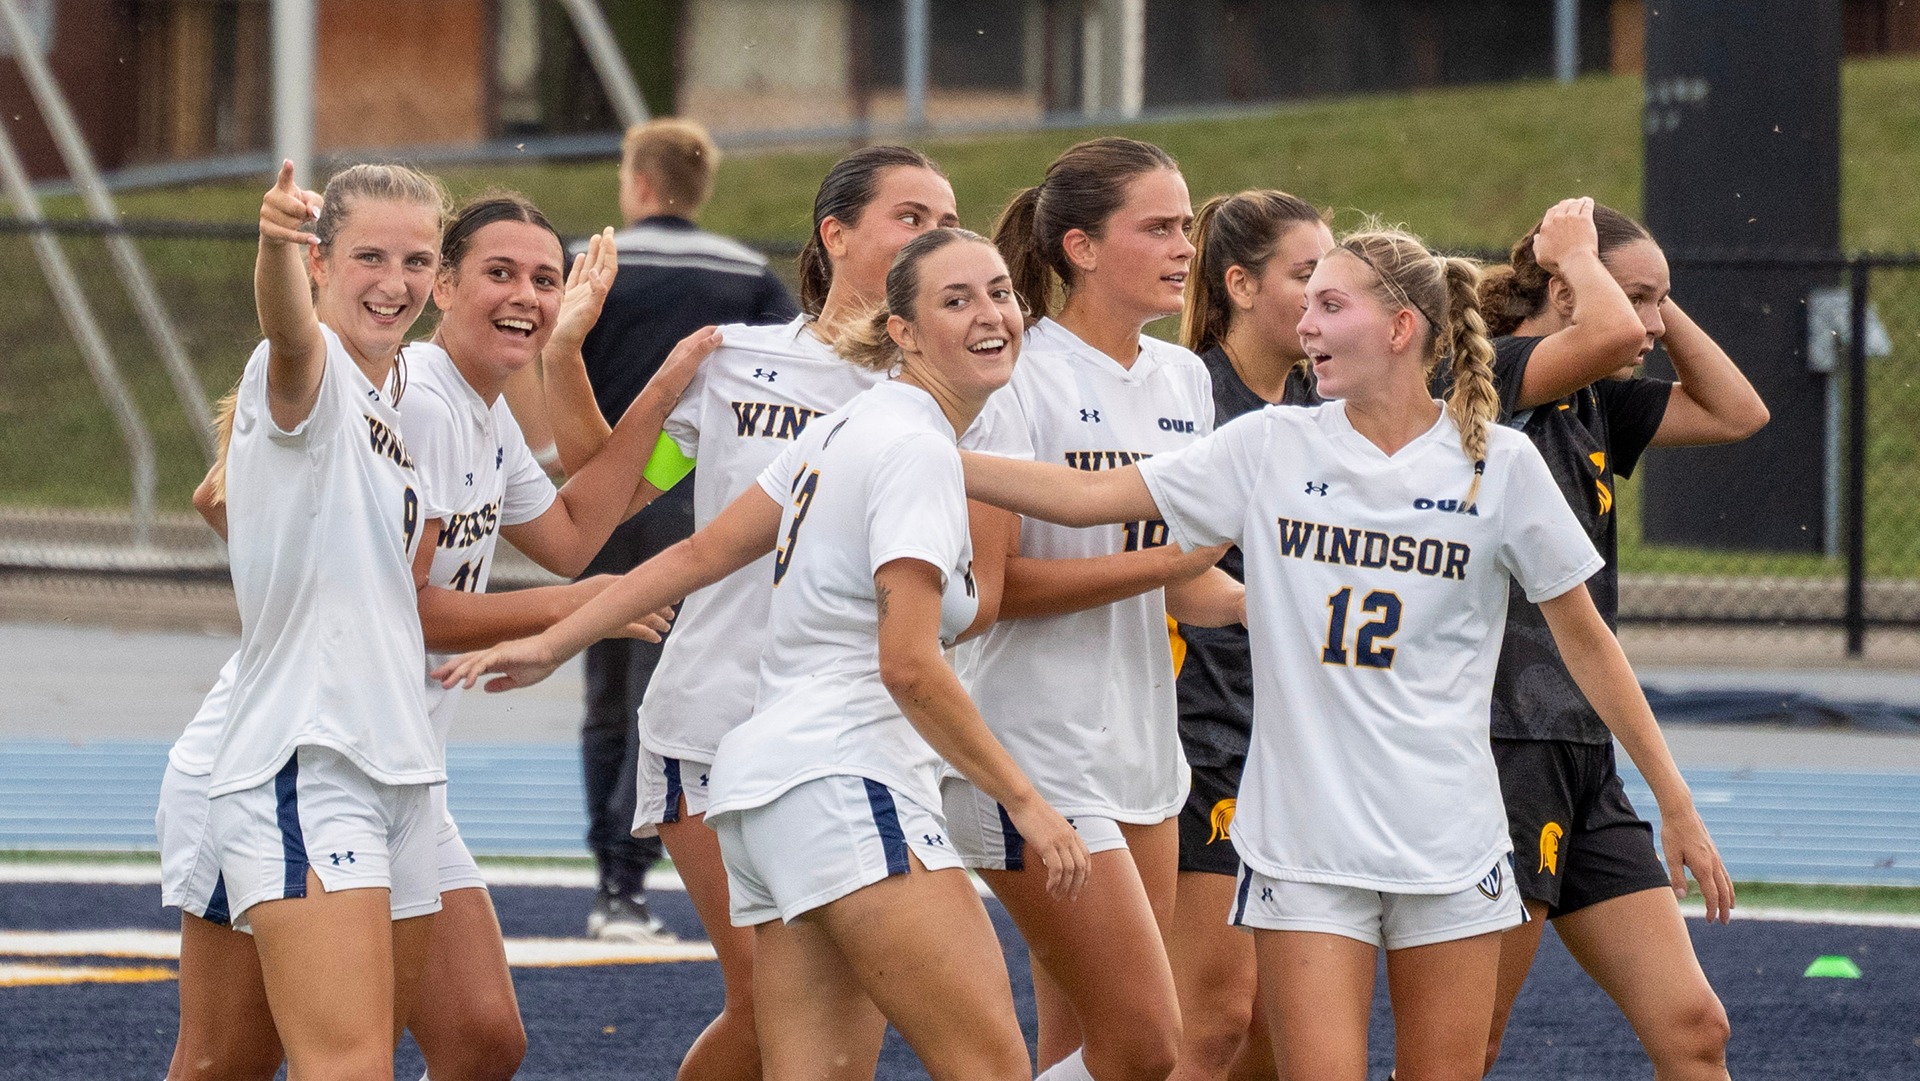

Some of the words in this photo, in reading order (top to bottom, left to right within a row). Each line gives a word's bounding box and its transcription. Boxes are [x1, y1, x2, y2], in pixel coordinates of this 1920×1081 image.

[730, 400, 828, 441] WIN
[402, 483, 419, 564] 9
[1412, 497, 1480, 517] OUA
[1277, 516, 1471, 581] WINDSOR
[1321, 585, 1403, 671] 12
